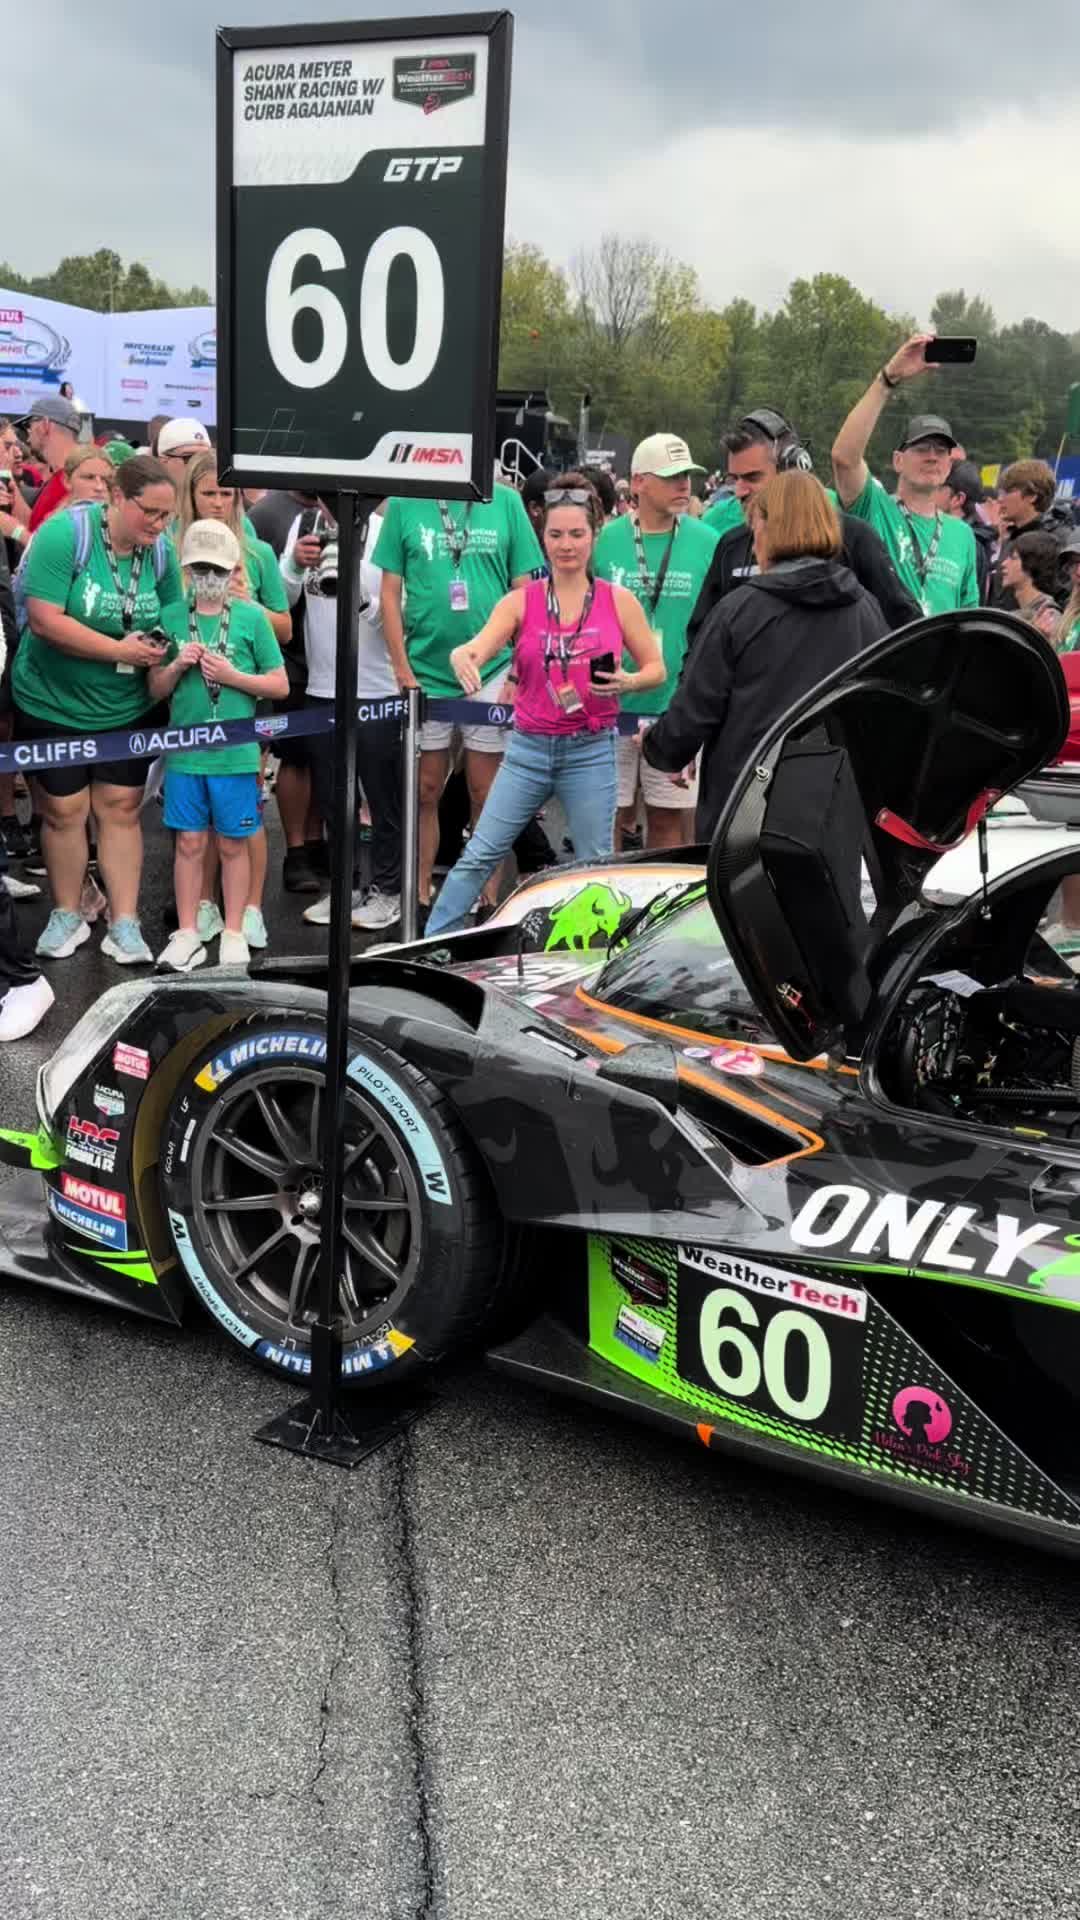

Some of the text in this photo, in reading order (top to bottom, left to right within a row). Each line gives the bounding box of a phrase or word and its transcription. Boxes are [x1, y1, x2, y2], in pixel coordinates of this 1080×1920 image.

[243, 60, 352, 81] ACURA MEYER
[244, 78, 385, 101] SHANK RACING W/
[244, 99, 374, 120] CURB AGAJANIAN
[383, 156, 463, 182] GTP
[265, 225, 444, 391] 60
[412, 448, 463, 464] IMSA
[14, 725, 227, 765] CLIFFS ACURA
[357, 1066, 420, 1134] PILOT SPORT
[67, 1115, 121, 1155] HRC
[64, 1177, 123, 1216] MOTUL
[57, 1203, 117, 1239] MICHELIN
[789, 1184, 1061, 1277] ONLY
[684, 1246, 859, 1314] WeatherTech
[193, 1274, 247, 1340] PILOT SPORT
[280, 1336, 297, 1350] LF
[700, 1288, 832, 1421] 60
